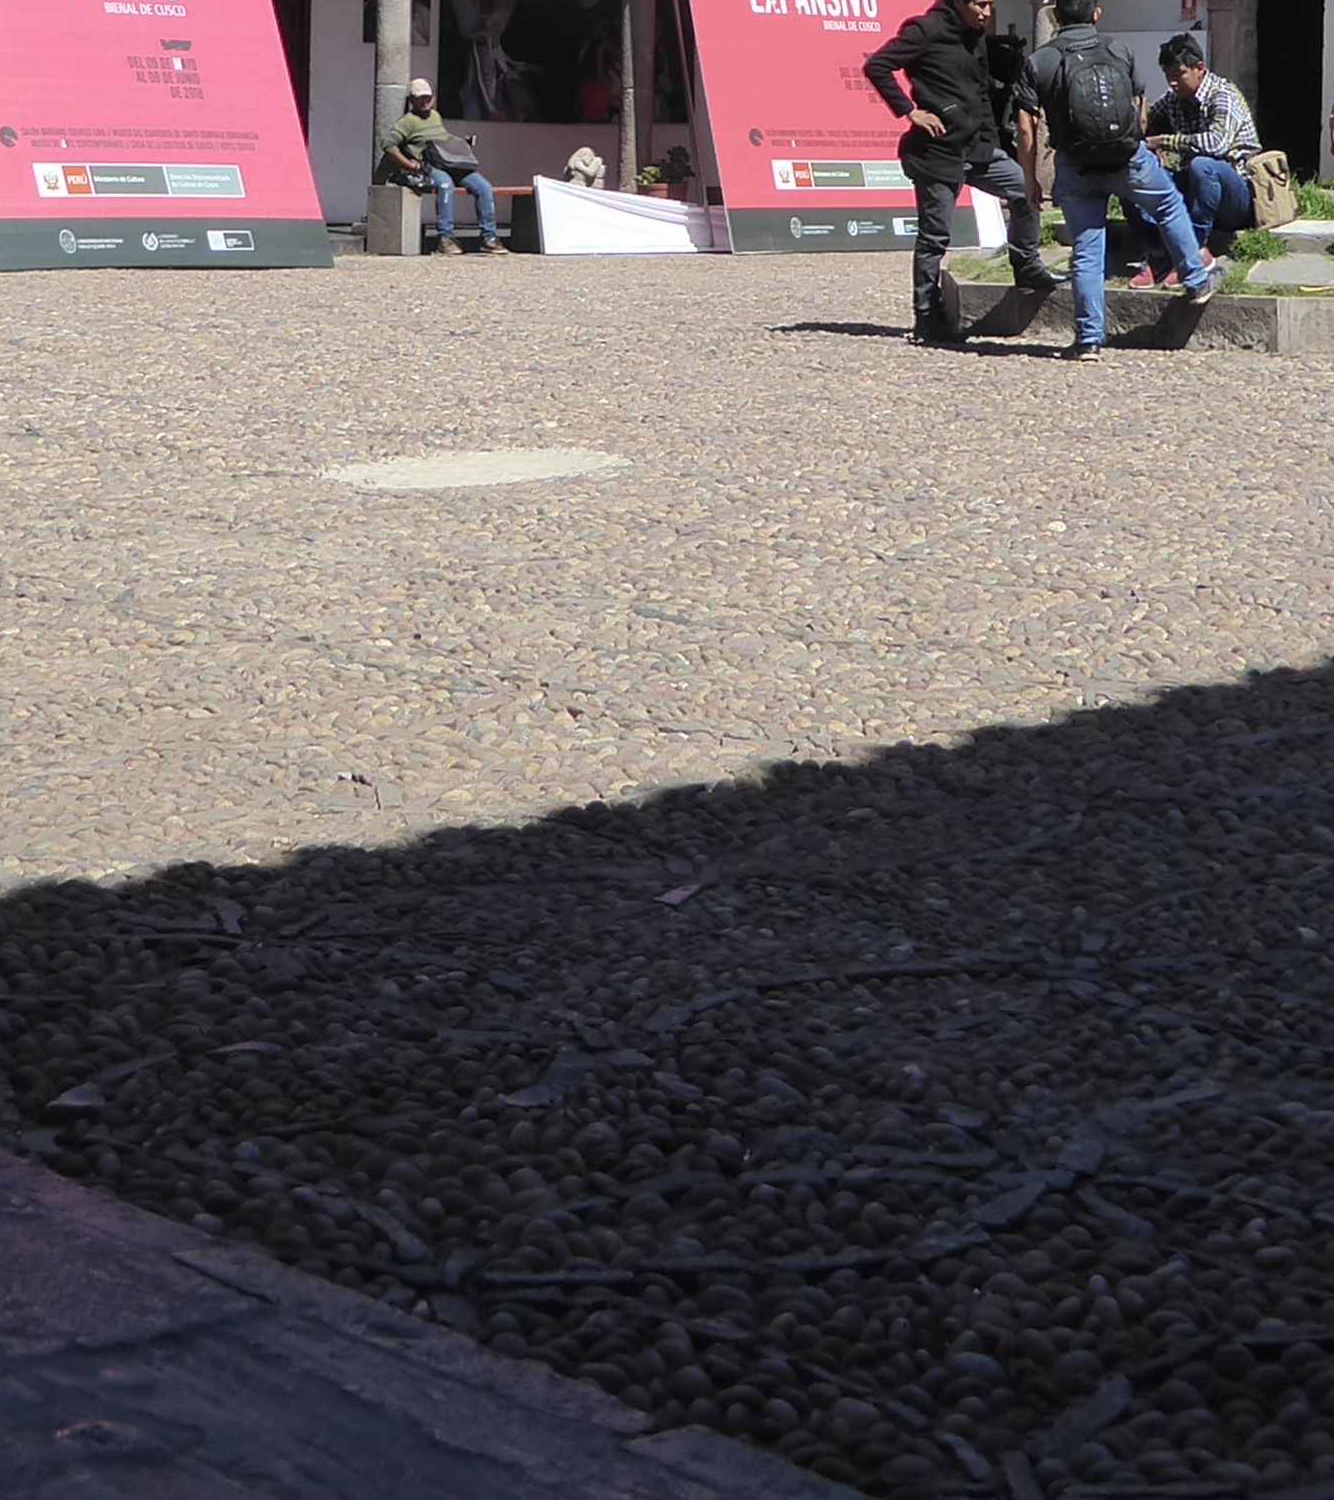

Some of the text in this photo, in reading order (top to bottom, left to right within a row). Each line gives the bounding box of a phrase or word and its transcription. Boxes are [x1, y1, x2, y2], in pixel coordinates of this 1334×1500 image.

[103, 1, 187, 17] BIENAL DE CUSCO
[823, 19, 882, 33] BIENAL DE CUSCO
[66, 173, 88, 185] PERÚ
